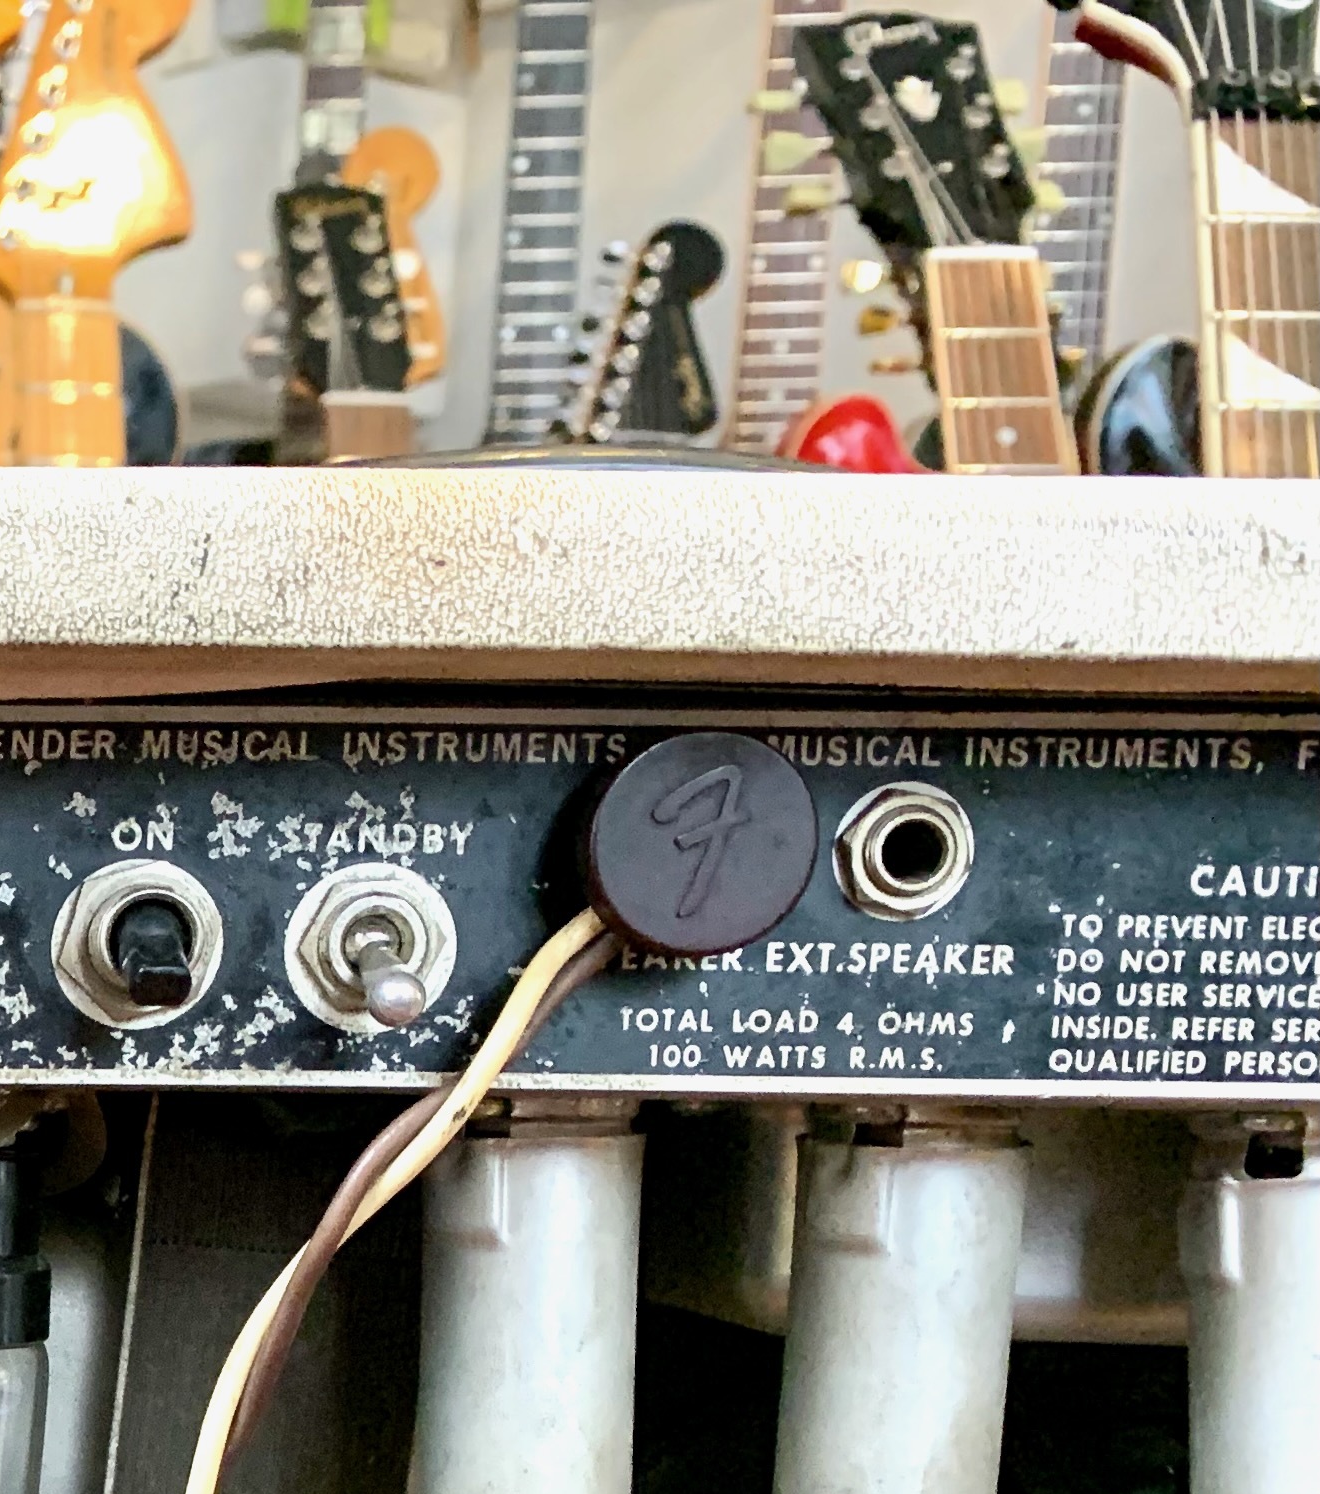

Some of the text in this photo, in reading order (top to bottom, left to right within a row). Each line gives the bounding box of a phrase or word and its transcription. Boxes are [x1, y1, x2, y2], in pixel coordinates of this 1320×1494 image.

[140, 729, 318, 763] MUSICAL
[343, 731, 627, 764] INSTRUMENTS
[767, 735, 941, 767] MUSICAL
[964, 736, 1264, 775] INSTRUMENTS,
[111, 820, 175, 852] ON
[277, 821, 473, 856] STANDBY
[1190, 865, 1319, 897] CAUTI
[1062, 914, 1104, 940] TO
[1117, 914, 1249, 941] PREVENT
[1057, 948, 1104, 973] DO
[1119, 949, 1186, 974] NOT
[1053, 981, 1320, 1009] NO USER SERVICE
[620, 1007, 714, 1033] TOTAL
[733, 1008, 820, 1034] LOAD
[877, 1010, 975, 1037] OHMS
[1051, 1015, 1157, 1040] INSIDE.
[1171, 1016, 1256, 1041] REFER
[649, 1044, 944, 1072] 100 WATTS R.M.S.
[1048, 1049, 1208, 1075] QUALIFIED
